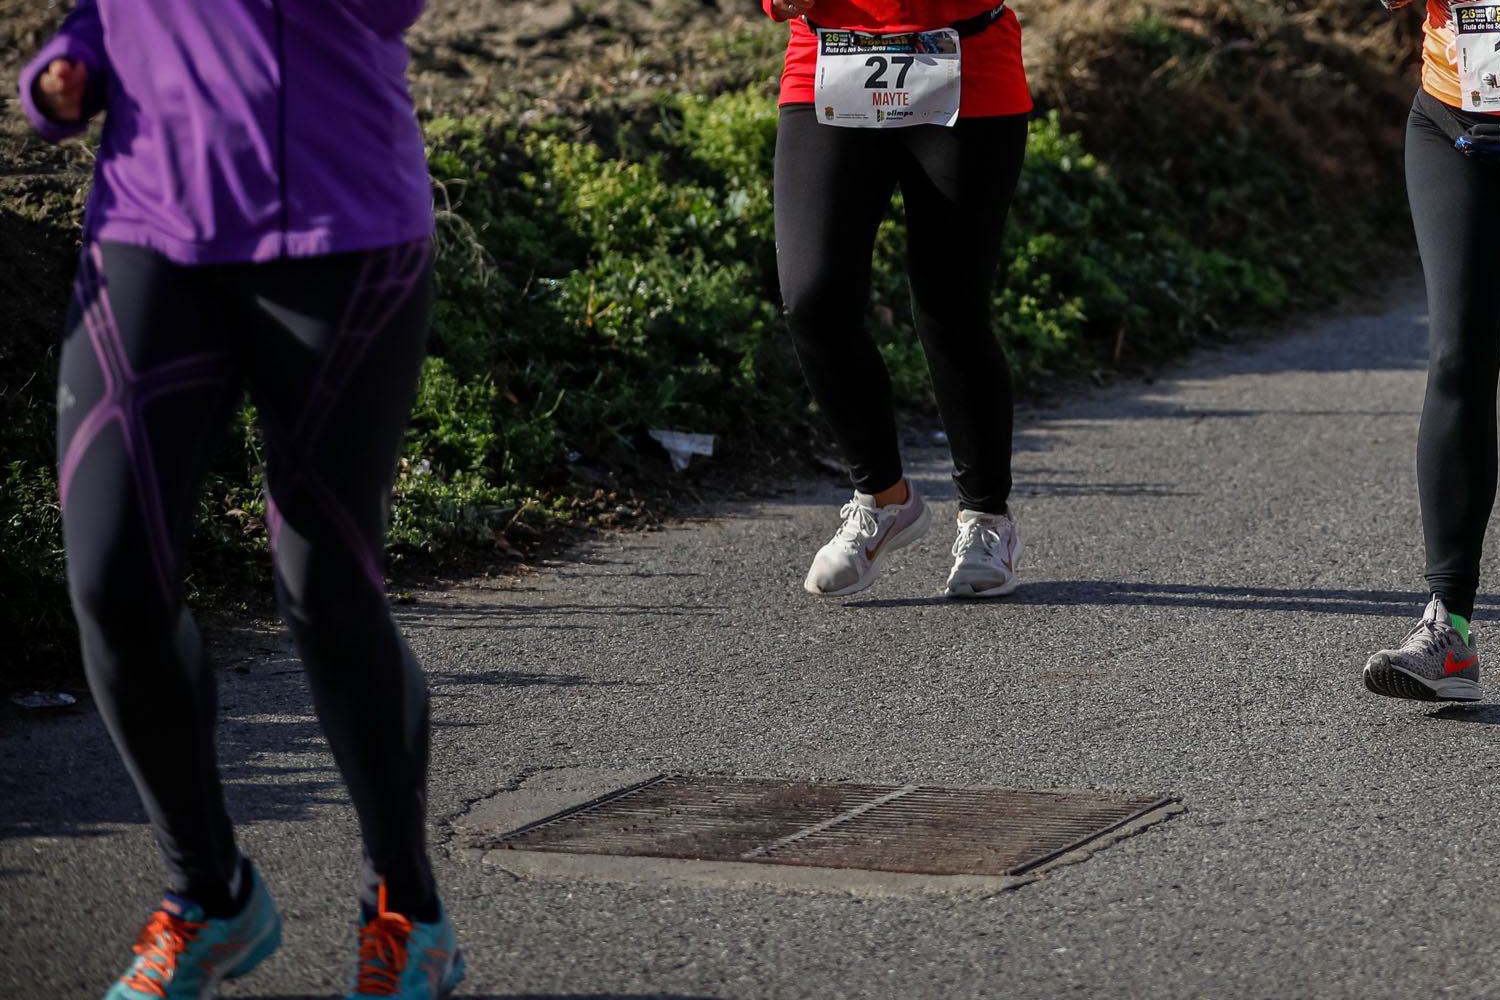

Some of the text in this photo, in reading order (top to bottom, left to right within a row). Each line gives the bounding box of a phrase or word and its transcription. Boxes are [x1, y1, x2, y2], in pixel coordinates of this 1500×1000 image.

[1461, 9, 1476, 19] 26
[825, 33, 839, 42] 26
[864, 56, 914, 89] 27
[872, 92, 909, 106] MAYTE
[886, 109, 914, 117] olimpo
